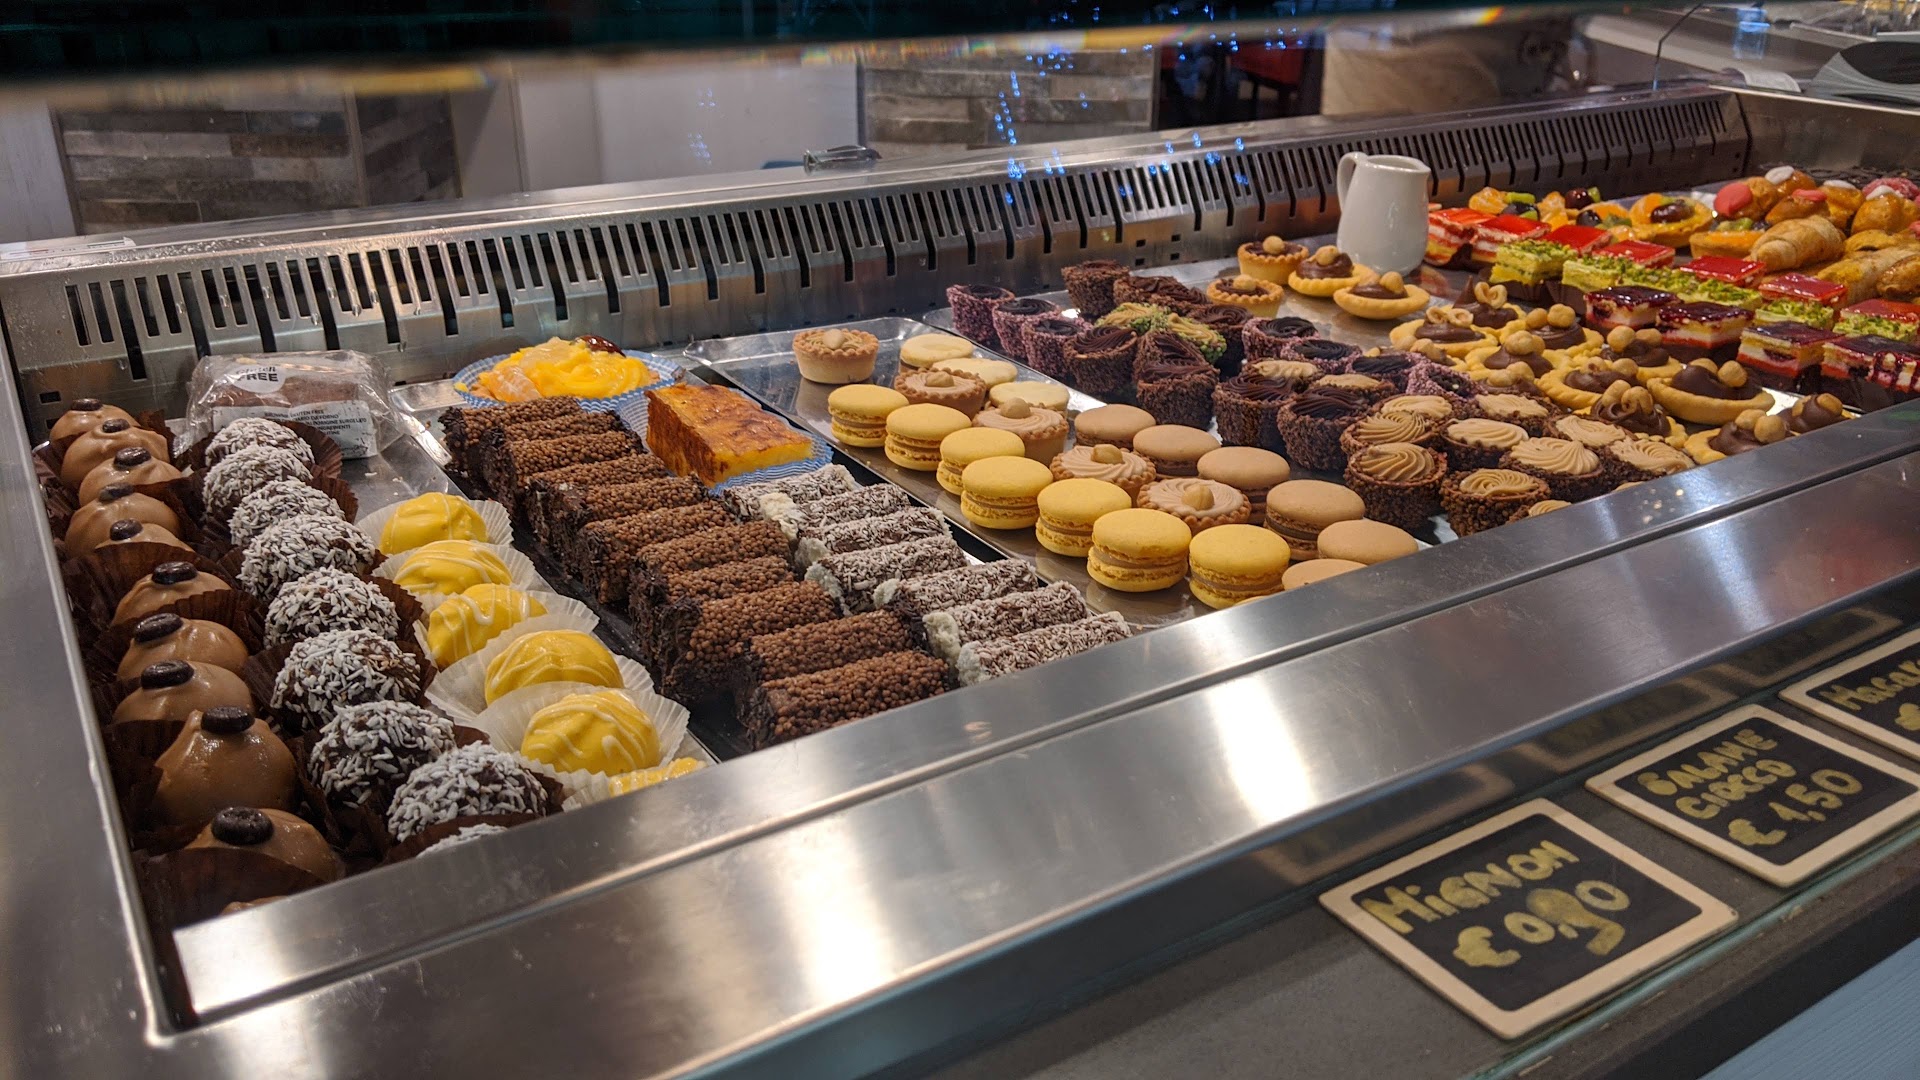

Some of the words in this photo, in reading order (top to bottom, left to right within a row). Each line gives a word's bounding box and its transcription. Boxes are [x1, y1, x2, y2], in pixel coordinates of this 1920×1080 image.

[237, 372, 279, 382] FREE
[1637, 728, 1778, 796] SALAME
[1768, 768, 1863, 822] 1,50
